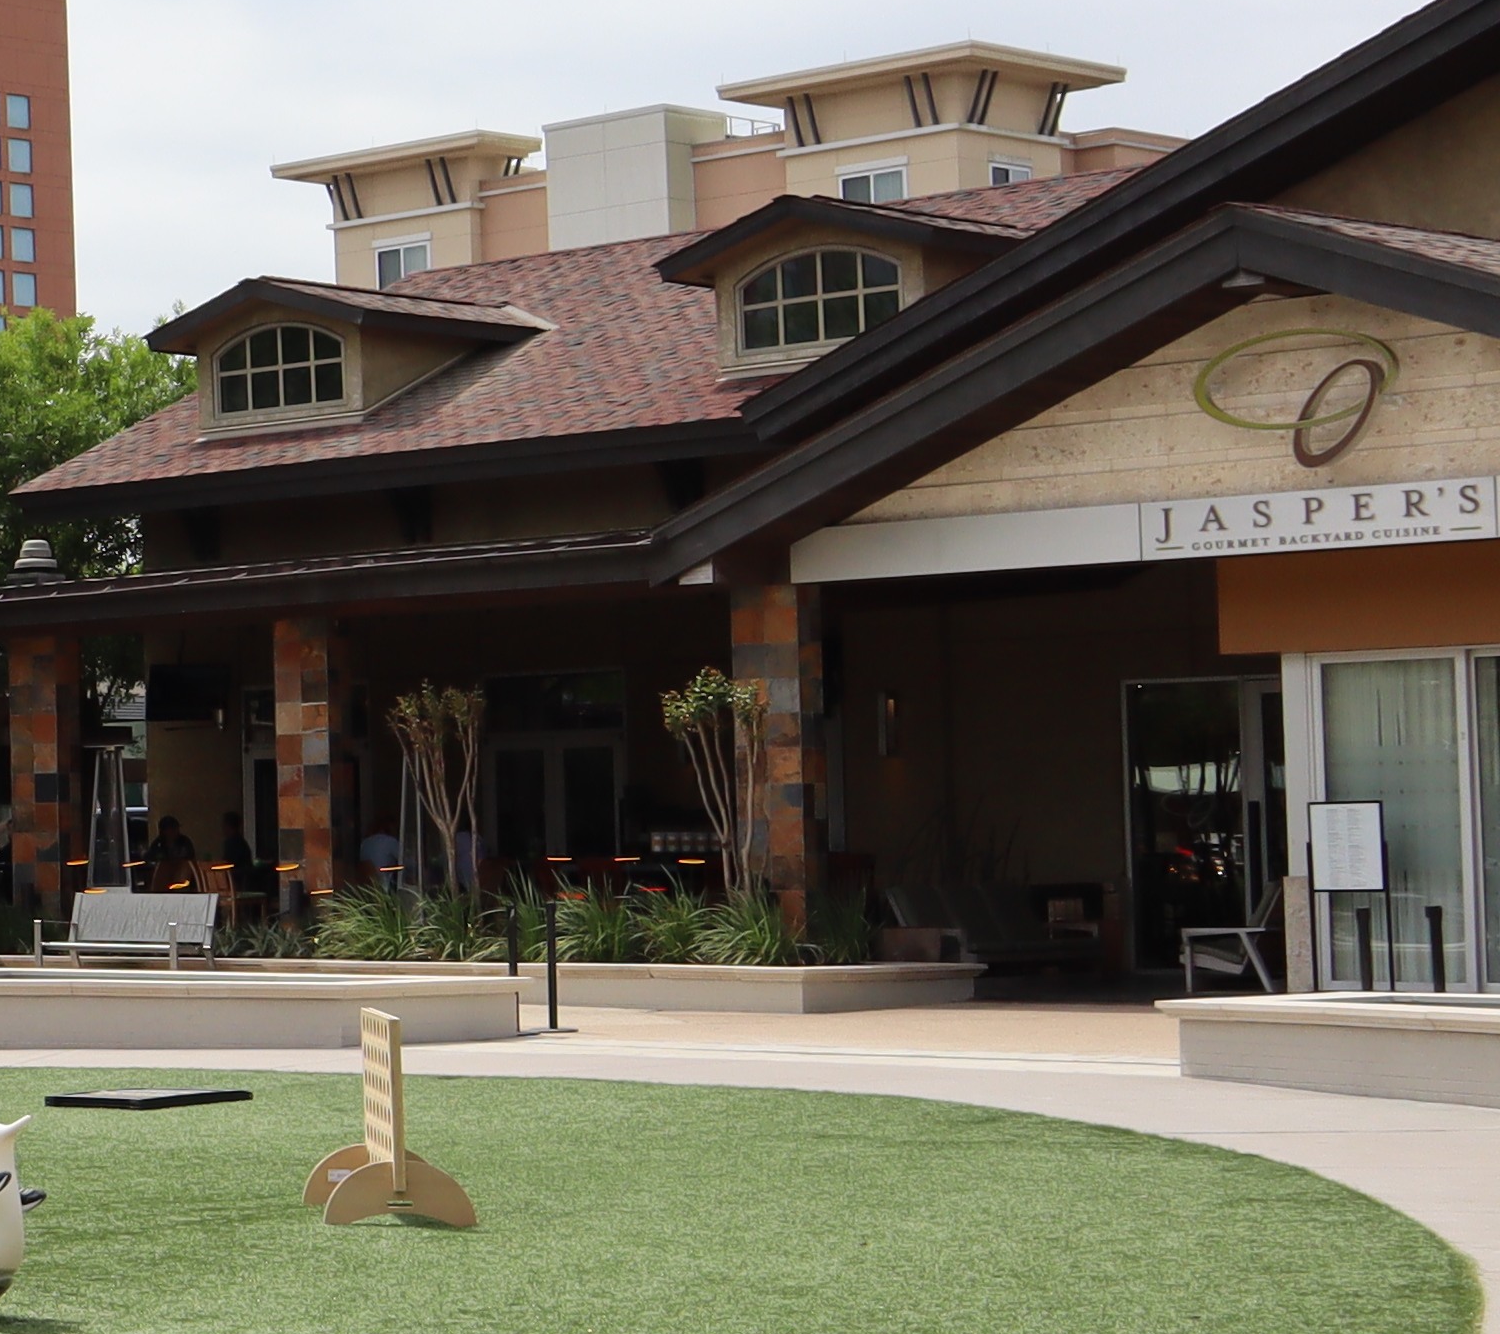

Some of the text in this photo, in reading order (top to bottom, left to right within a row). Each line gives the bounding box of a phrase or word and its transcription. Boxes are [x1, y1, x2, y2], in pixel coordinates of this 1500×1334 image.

[1155, 484, 1482, 545] JASPER'S
[1191, 525, 1442, 552] GOURMET BACKYARD CUISINE
